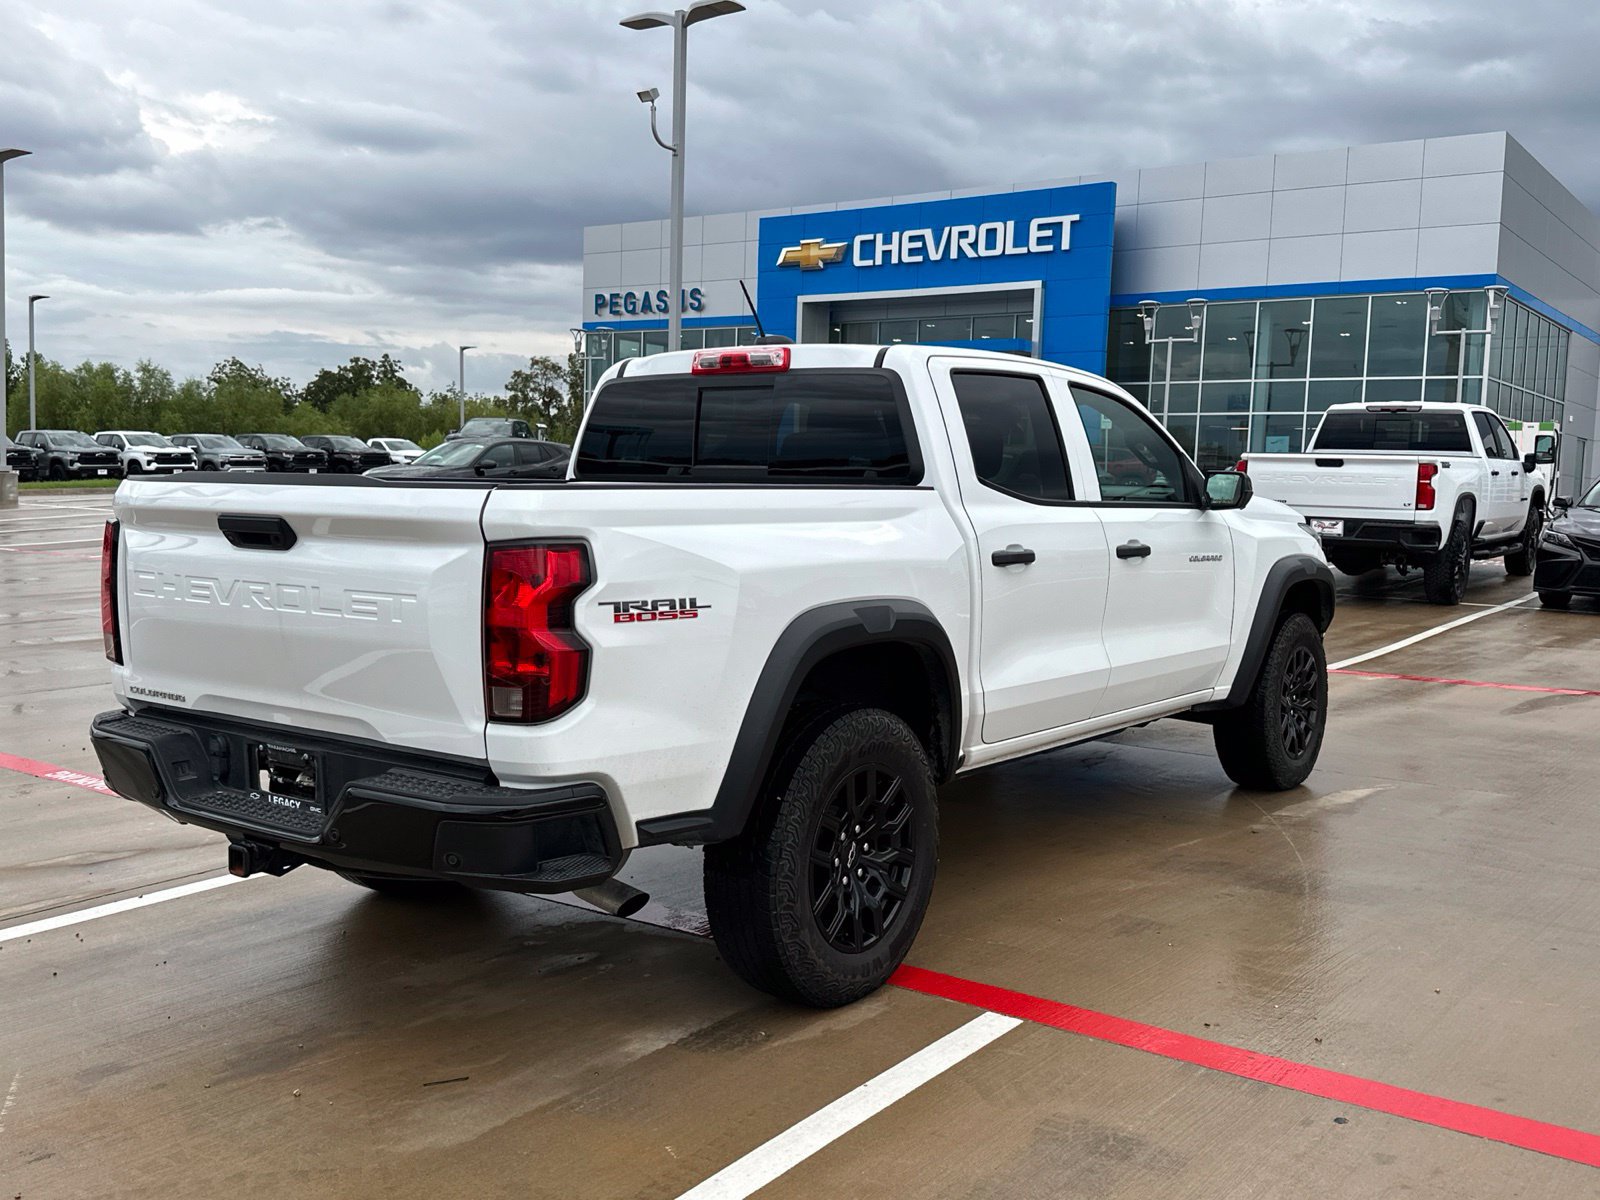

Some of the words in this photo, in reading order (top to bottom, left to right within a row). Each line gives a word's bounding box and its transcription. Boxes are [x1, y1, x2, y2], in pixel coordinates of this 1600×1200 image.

[852, 213, 1080, 267] CHEVROLET
[133, 568, 418, 624] CHEVROLET
[598, 597, 712, 614] TRAIL
[613, 609, 699, 624] BOSS
[267, 794, 301, 809] LEGACY
